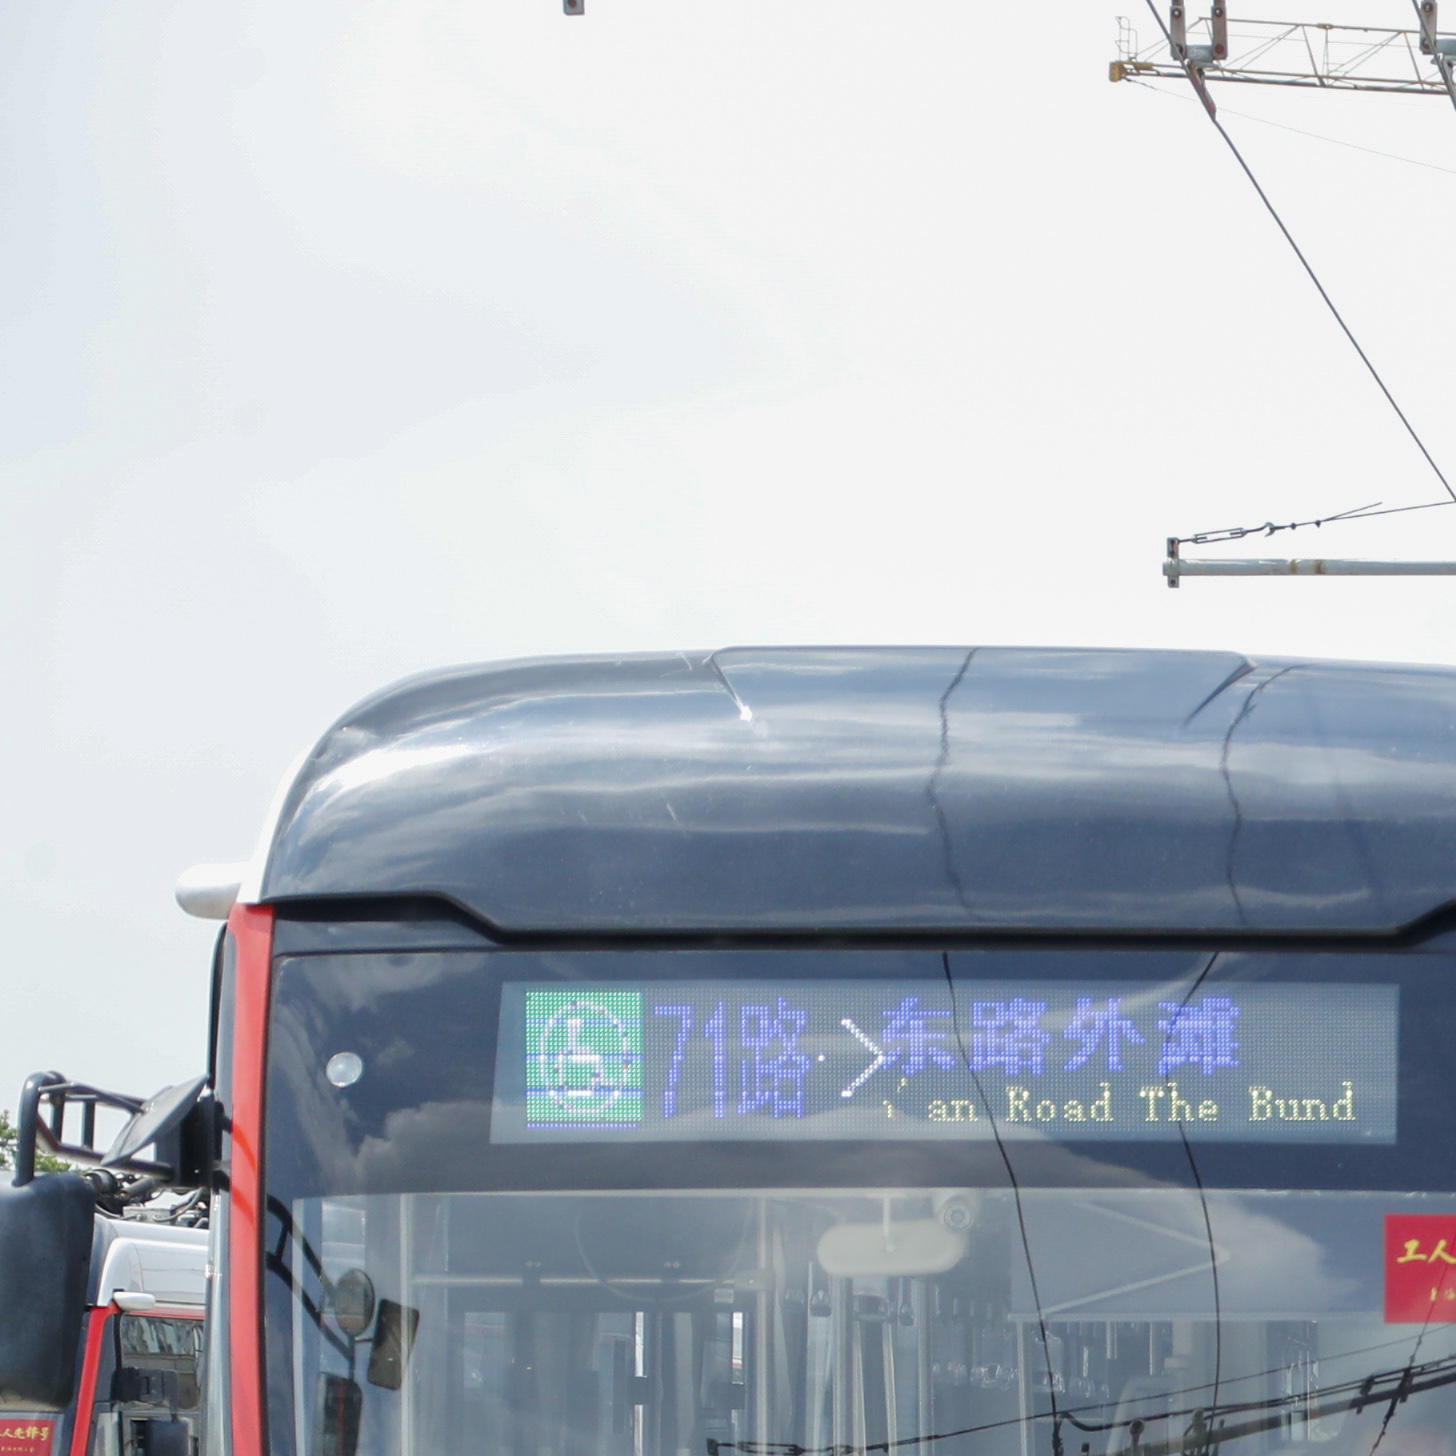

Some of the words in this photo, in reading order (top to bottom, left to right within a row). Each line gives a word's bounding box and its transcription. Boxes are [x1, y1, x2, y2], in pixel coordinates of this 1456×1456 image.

[653, 996, 812, 1119] 71路
[1005, 1082, 1115, 1122] Road
[1140, 1082, 1218, 1122] The
[1248, 1081, 1357, 1122] Bund
